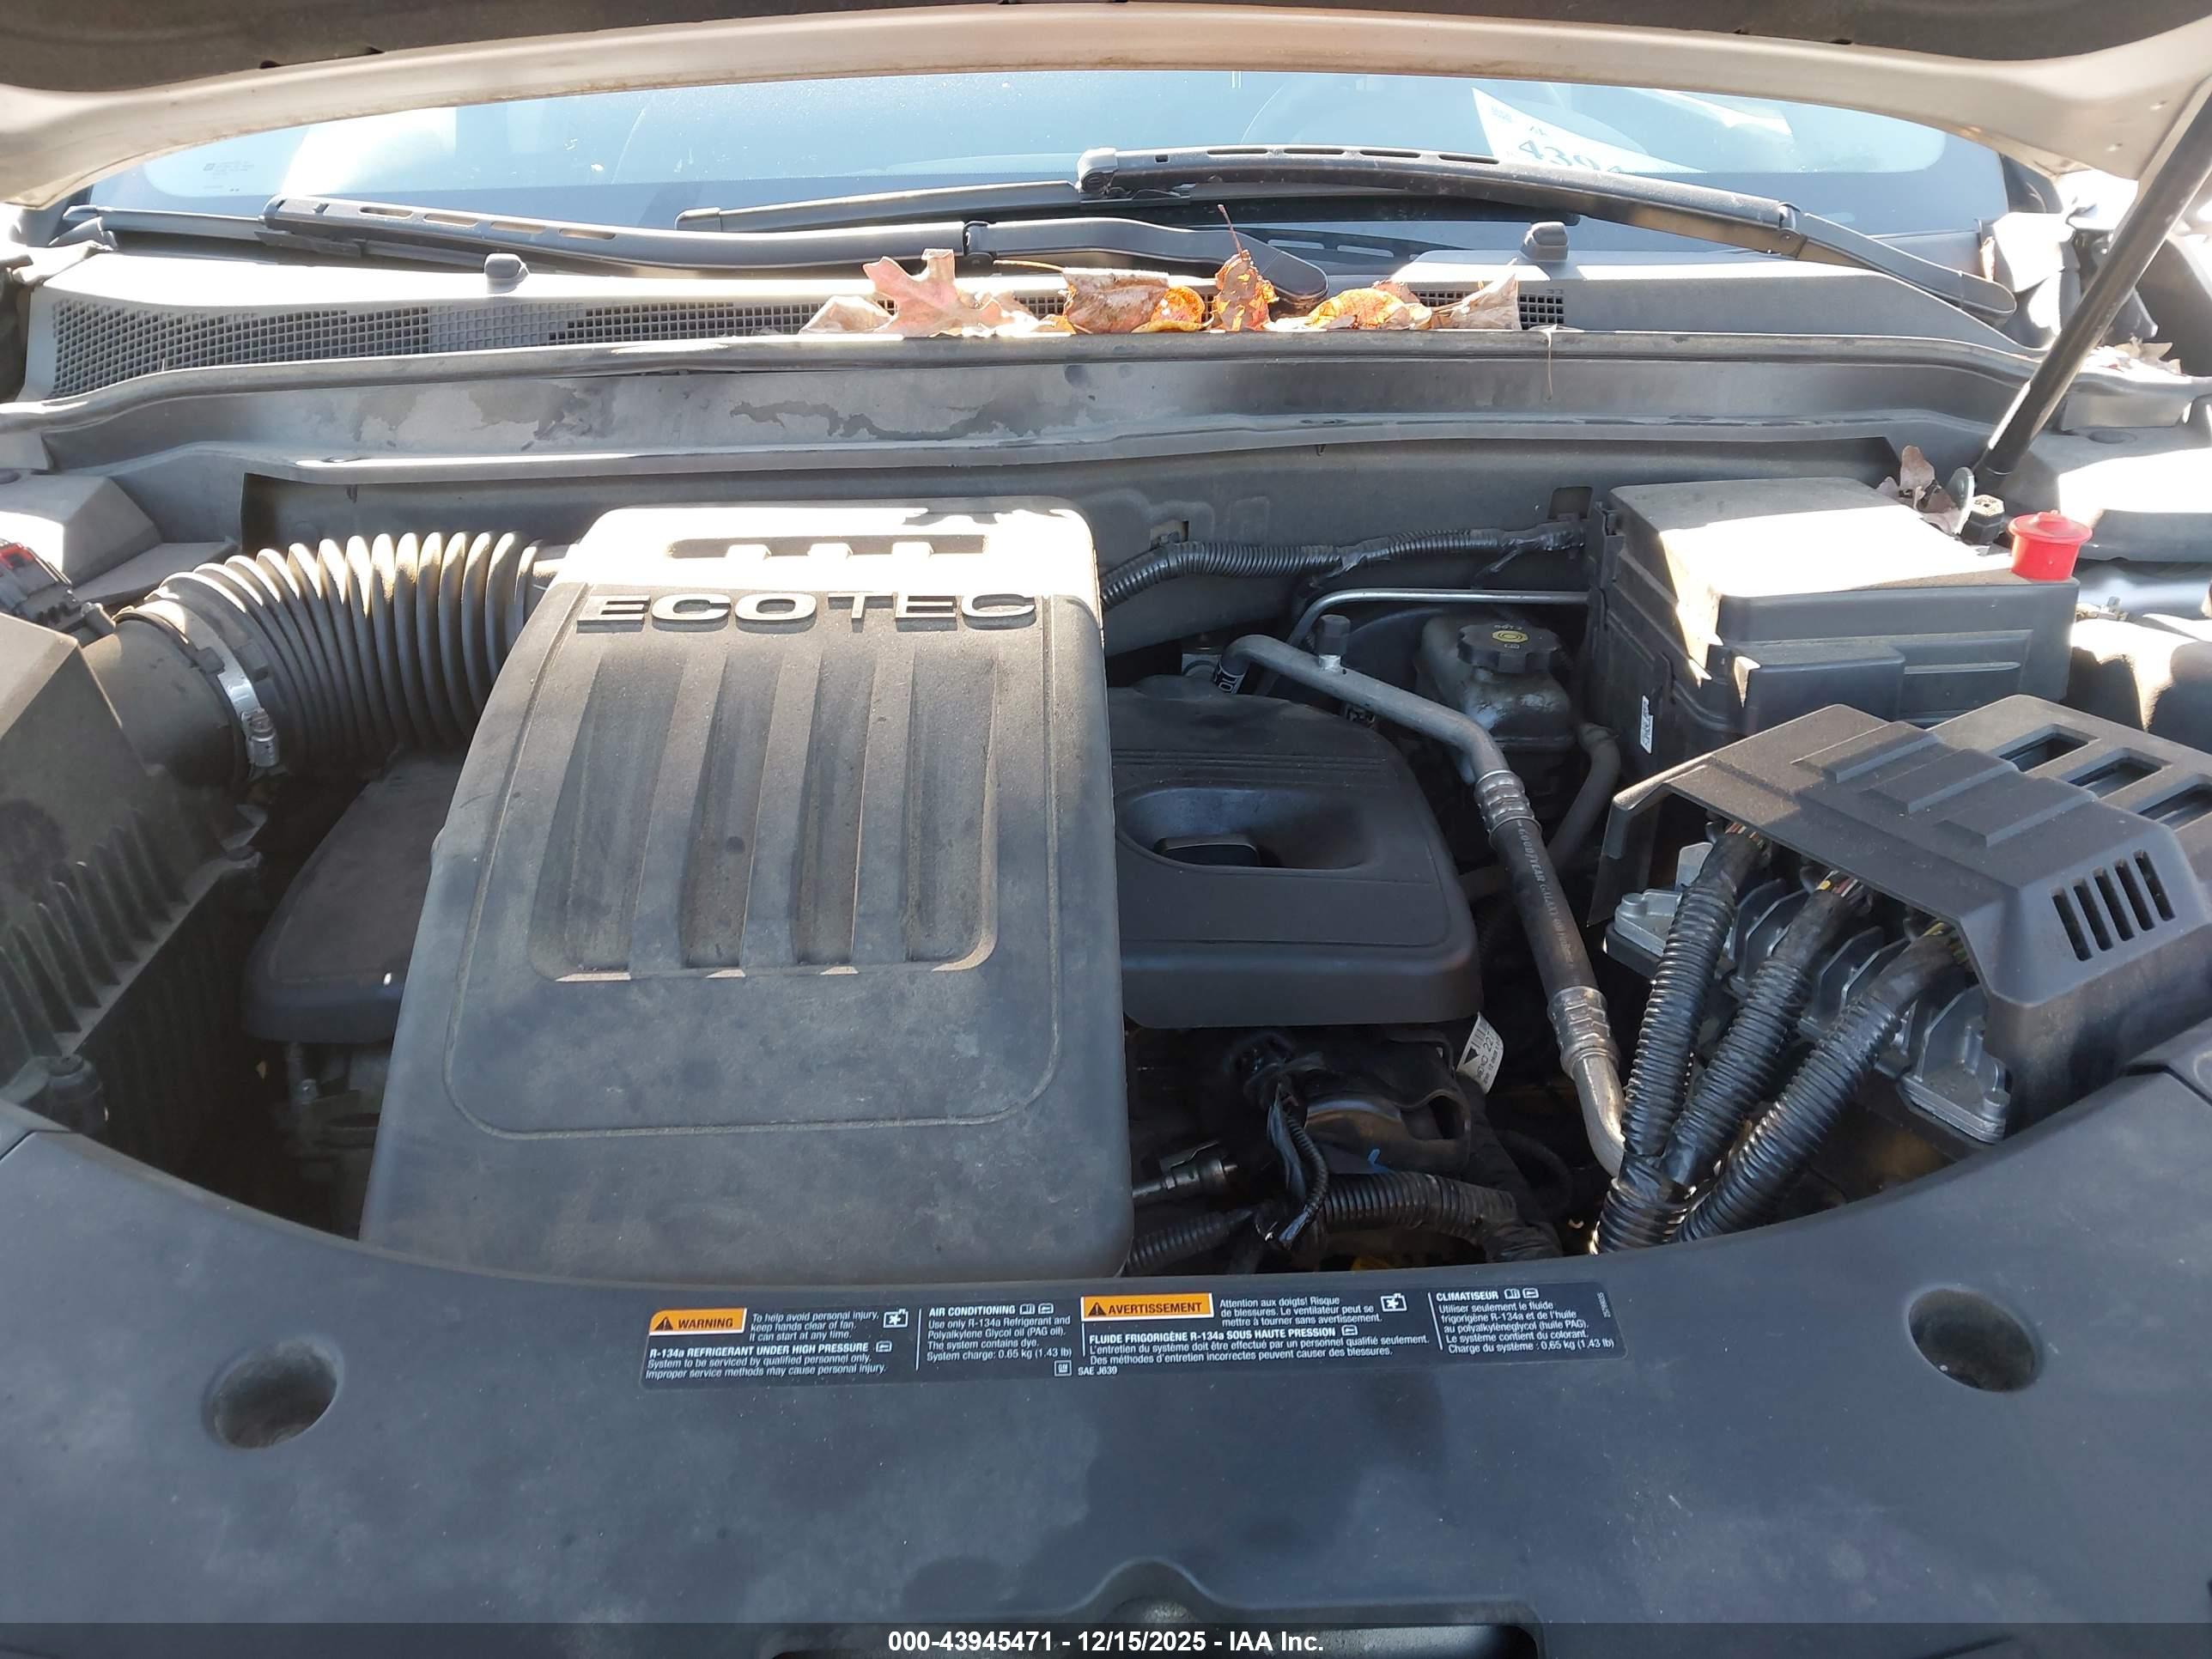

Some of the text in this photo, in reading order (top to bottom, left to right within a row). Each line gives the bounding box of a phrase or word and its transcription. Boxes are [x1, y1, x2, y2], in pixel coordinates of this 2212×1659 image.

[1518, 139, 1623, 173] 439
[576, 592, 1037, 634] ECOTEC
[1219, 1296, 1340, 1309] Attention aux doigts! Risque
[1436, 1291, 1499, 1302] CLIMATISEUR
[928, 1305, 1016, 1317] AIR CONDITIONING
[1108, 1302, 1202, 1316] AVERTISSEMENT
[1220, 1304, 1374, 1318] de blessures. Le ventilateur peut se
[1439, 1301, 1553, 1314] Utiliser seulement le fluide
[678, 1318, 733, 1328] WARNING
[752, 1313, 763, 1322] To
[764, 1313, 784, 1324] help
[786, 1312, 810, 1322] avoid
[811, 1311, 850, 1324] personal
[928, 1316, 1071, 1330] Use only R-134a Refrigerant and
[1222, 1318, 1251, 1328] mettre
[1261, 1316, 1293, 1326] tourner
[1295, 1316, 1316, 1325] sans
[1318, 1313, 1382, 1324] avertissement.
[1491, 1312, 1524, 1322] R-134a
[1526, 1312, 1535, 1321] et
[1537, 1311, 1548, 1321] de
[750, 1323, 773, 1334] keep
[775, 1321, 802, 1331] hands
[804, 1321, 826, 1330] clear
[828, 1320, 838, 1330] of
[927, 1328, 982, 1341] Polyalkylene
[985, 1328, 1012, 1340] Glycol
[1013, 1327, 1024, 1338] oil
[1027, 1326, 1048, 1338] (PAG
[1443, 1326, 1455, 1334] au
[1539, 1320, 1564, 1331] (huile
[757, 1333, 774, 1342] can
[776, 1332, 797, 1341] start
[799, 1332, 809, 1340] at
[810, 1332, 828, 1342] any
[830, 1330, 852, 1340] time.
[1089, 1333, 1122, 1345] FLUIDE
[1190, 1331, 1224, 1341] R-134a
[1226, 1329, 1253, 1340] SOUS
[1255, 1328, 1286, 1340] HAUTE
[1288, 1327, 1336, 1339] PRESSION
[1446, 1329, 1589, 1345] Le système contient du colorant.
[650, 1342, 869, 1358] R-134a REFRIGERANT UNDER HIGH PRESSURE
[927, 1337, 1040, 1352] The system contains dye.
[1090, 1344, 1136, 1355] L'entretien
[1139, 1343, 1150, 1353] du
[1152, 1342, 1189, 1355] système
[1192, 1341, 1209, 1352] doit
[1269, 1341, 1285, 1351] par
[1286, 1340, 1297, 1349] un
[1300, 1338, 1344, 1350] personnel
[1381, 1334, 1430, 1346] seulement.
[1449, 1345, 1481, 1355] Charge
[1483, 1344, 1494, 1353] du
[1496, 1342, 1534, 1353] système
[1564, 1340, 1576, 1352] kg
[1602, 1338, 1614, 1349] lb)
[647, 1352, 872, 1370] System to be serviced by qualified personnel only.
[927, 1351, 960, 1364] System
[962, 1349, 997, 1362] charge:
[998, 1348, 1019, 1358] 0.65
[1020, 1347, 1033, 1360] kg
[1060, 1346, 1073, 1358] lb)
[1091, 1346, 1393, 1365] Des méthodes d'entretien incorrectes peuvent causer des blessures.
[646, 1363, 887, 1381] Improper service methods may cause personal injury.
[1078, 1365, 1117, 1376] SAE J639
